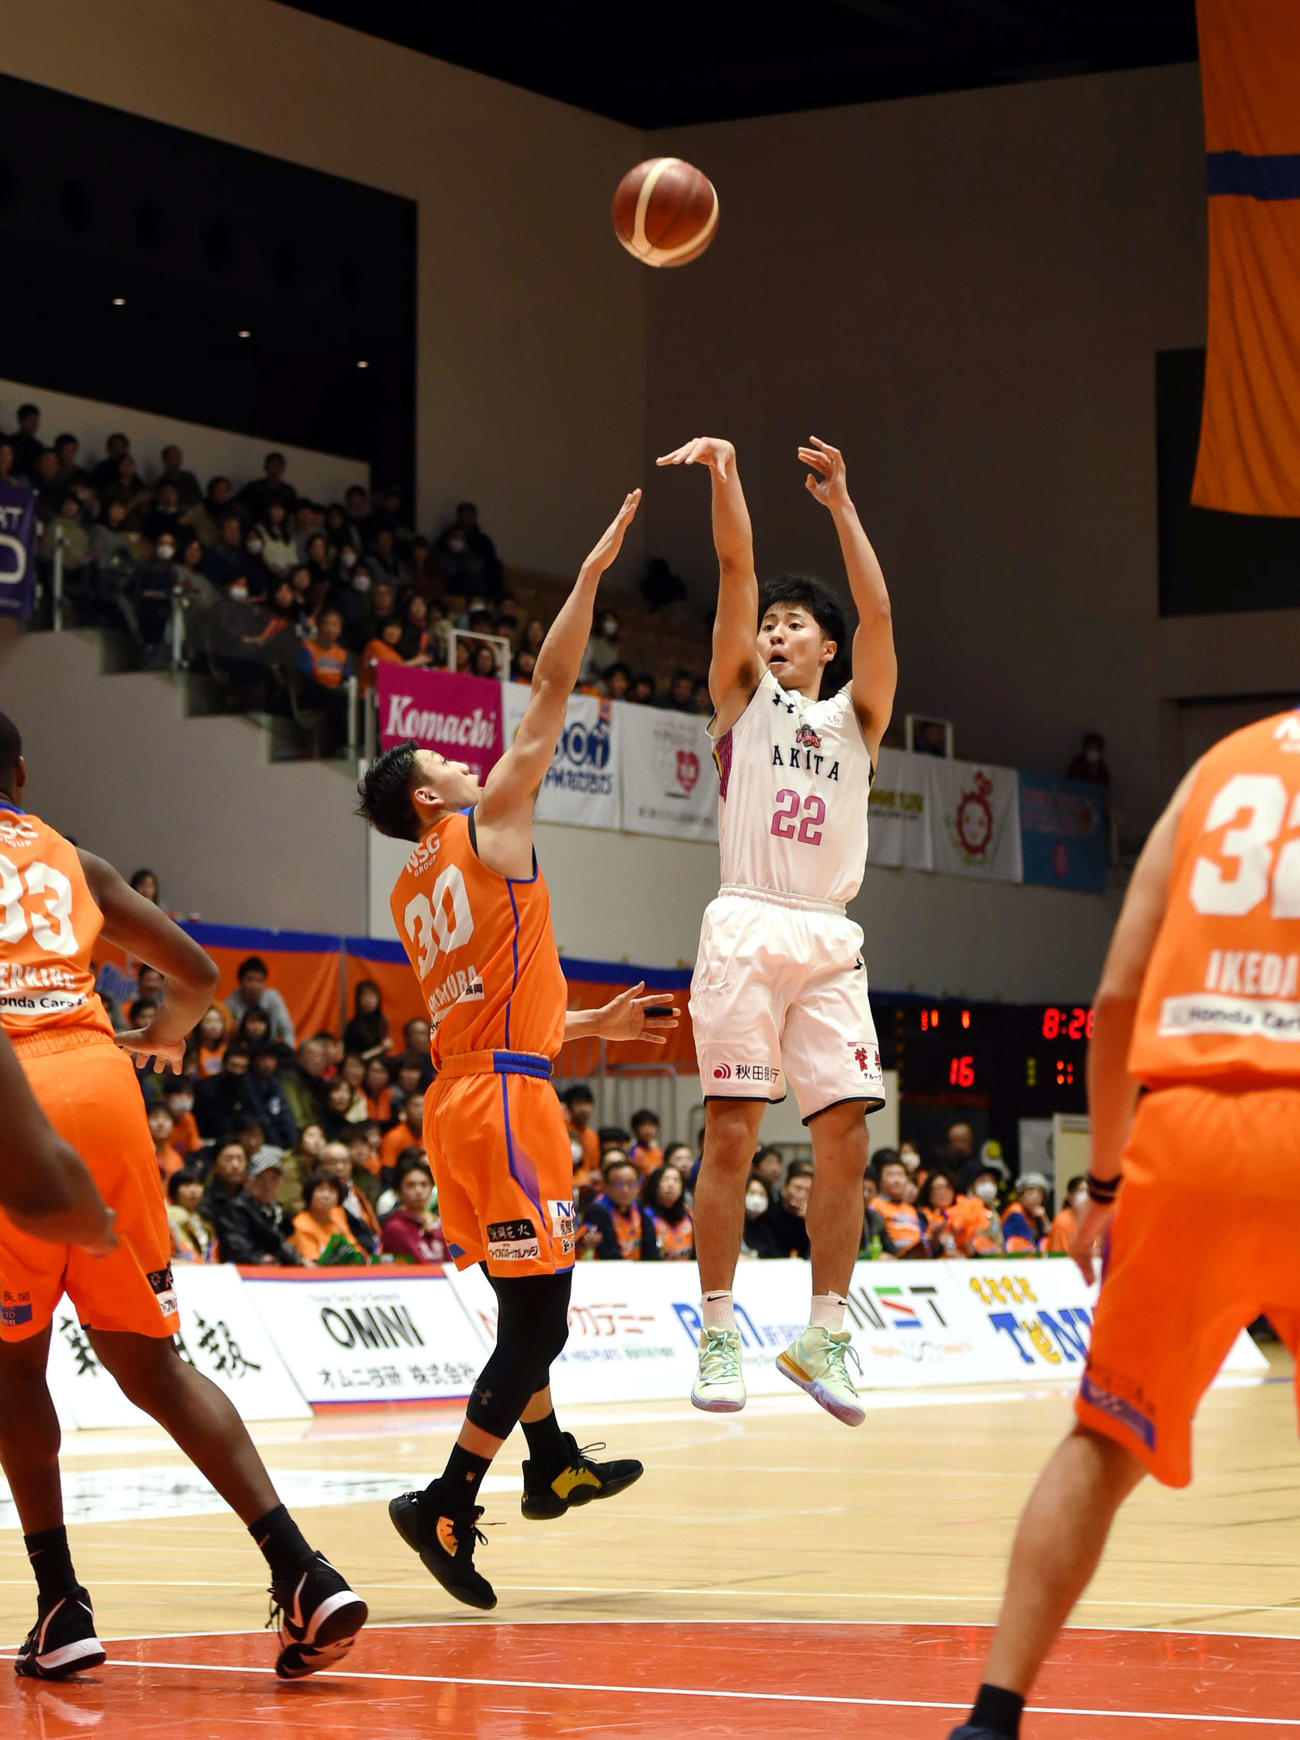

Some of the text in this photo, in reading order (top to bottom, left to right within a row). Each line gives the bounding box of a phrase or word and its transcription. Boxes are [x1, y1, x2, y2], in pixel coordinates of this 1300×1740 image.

[384, 694, 497, 750] Komachi
[772, 745, 840, 782] AKITA
[769, 788, 827, 847] 22
[406, 831, 441, 874] NSG
[404, 863, 475, 981] 30
[0, 996, 36, 1010] onda
[950, 1056, 975, 1087] 16
[320, 1305, 426, 1349] OMNI
[988, 1307, 1089, 1364] TeN
